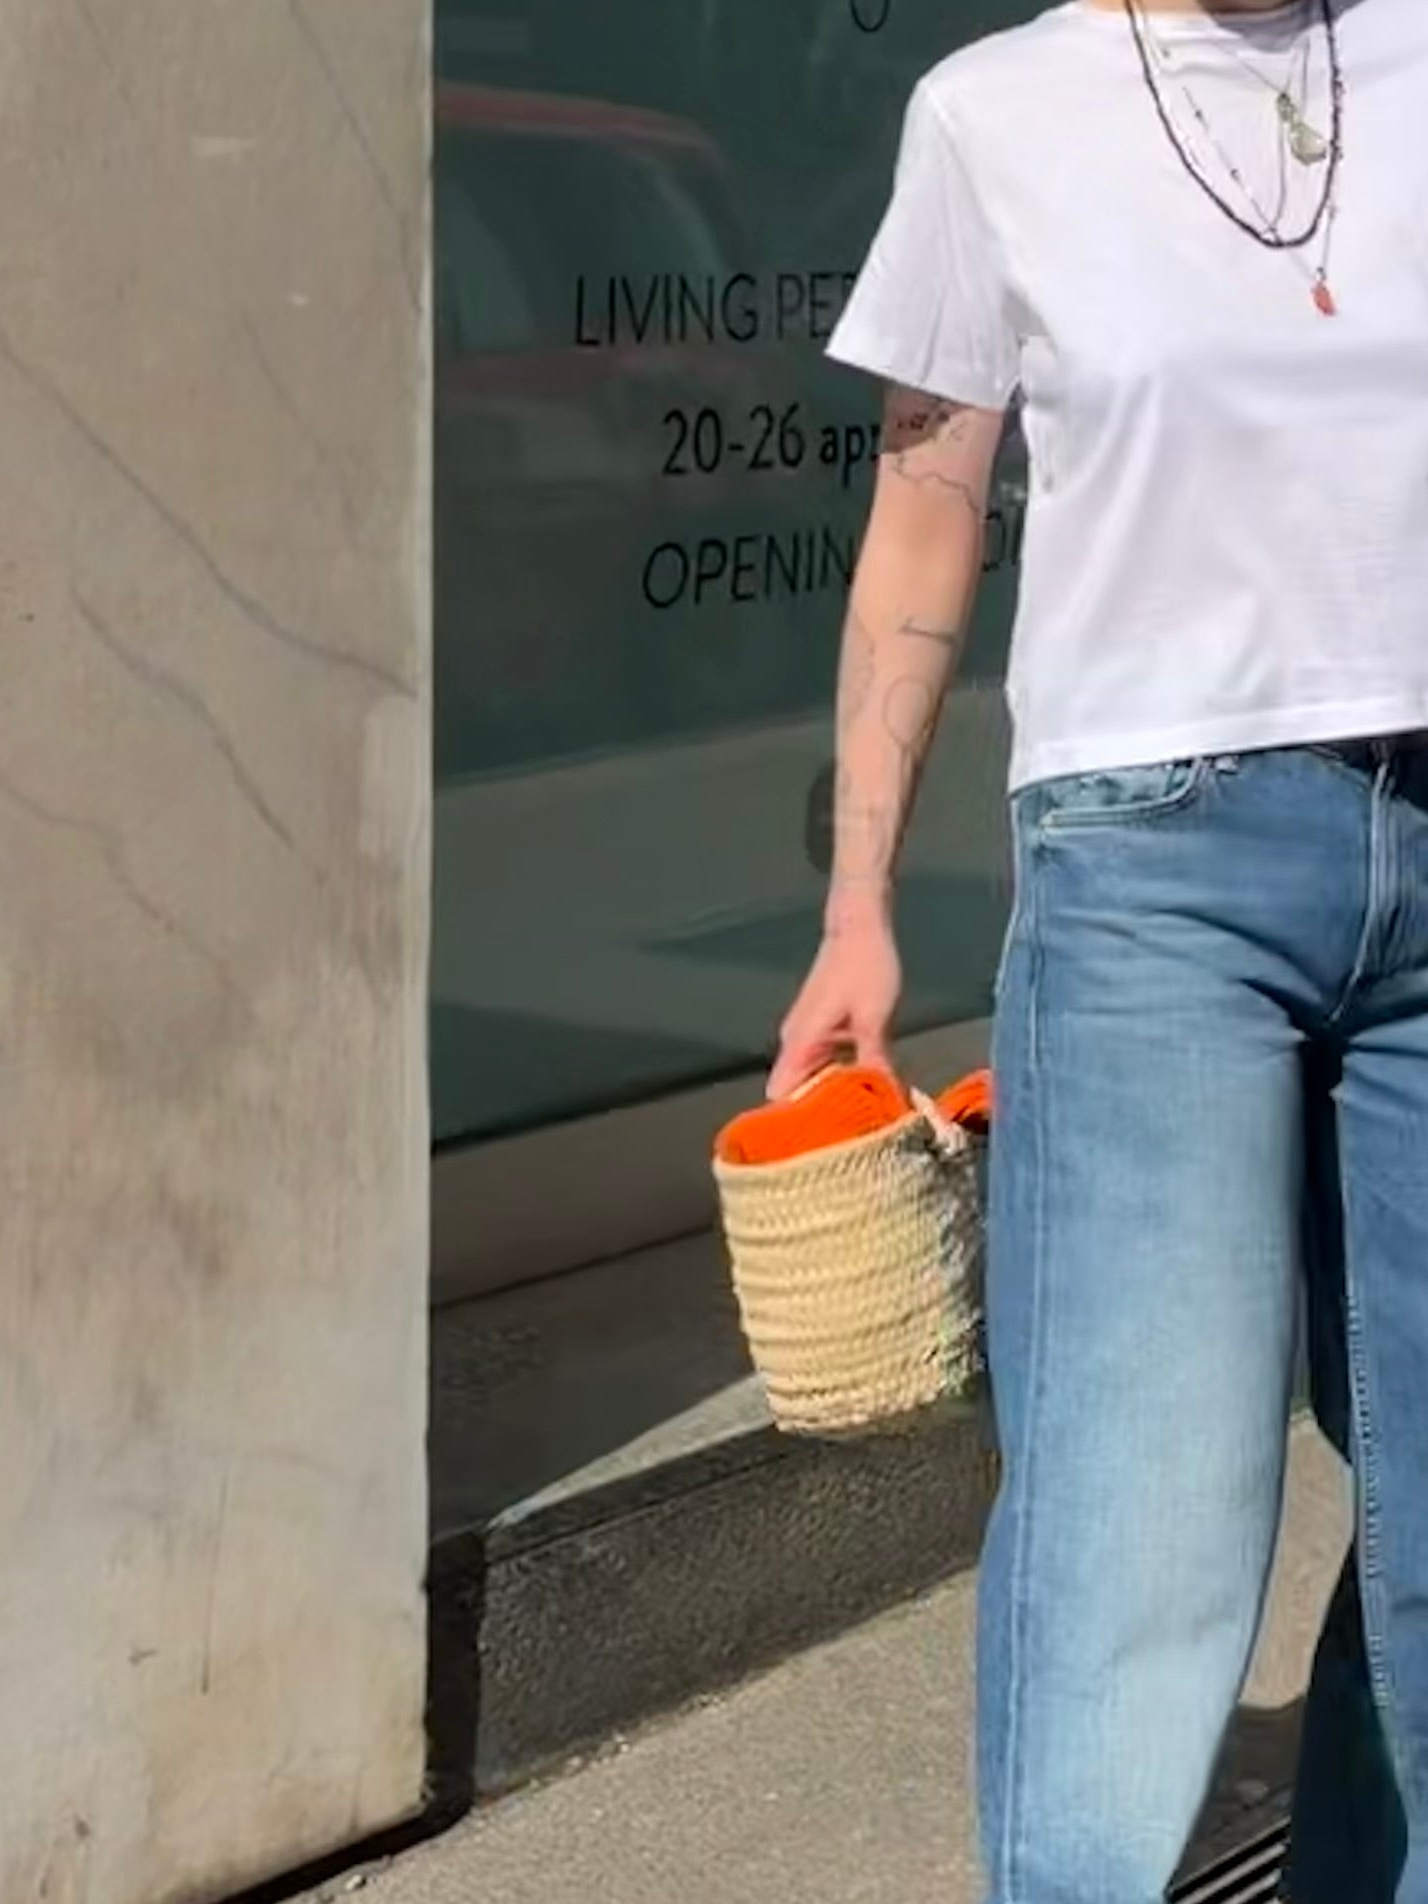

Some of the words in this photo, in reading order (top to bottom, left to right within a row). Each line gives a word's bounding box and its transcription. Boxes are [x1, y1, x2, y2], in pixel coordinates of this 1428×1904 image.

[575, 272, 759, 348] LIVING
[661, 402, 806, 476] 20-26
[642, 528, 854, 610] OPENIN
